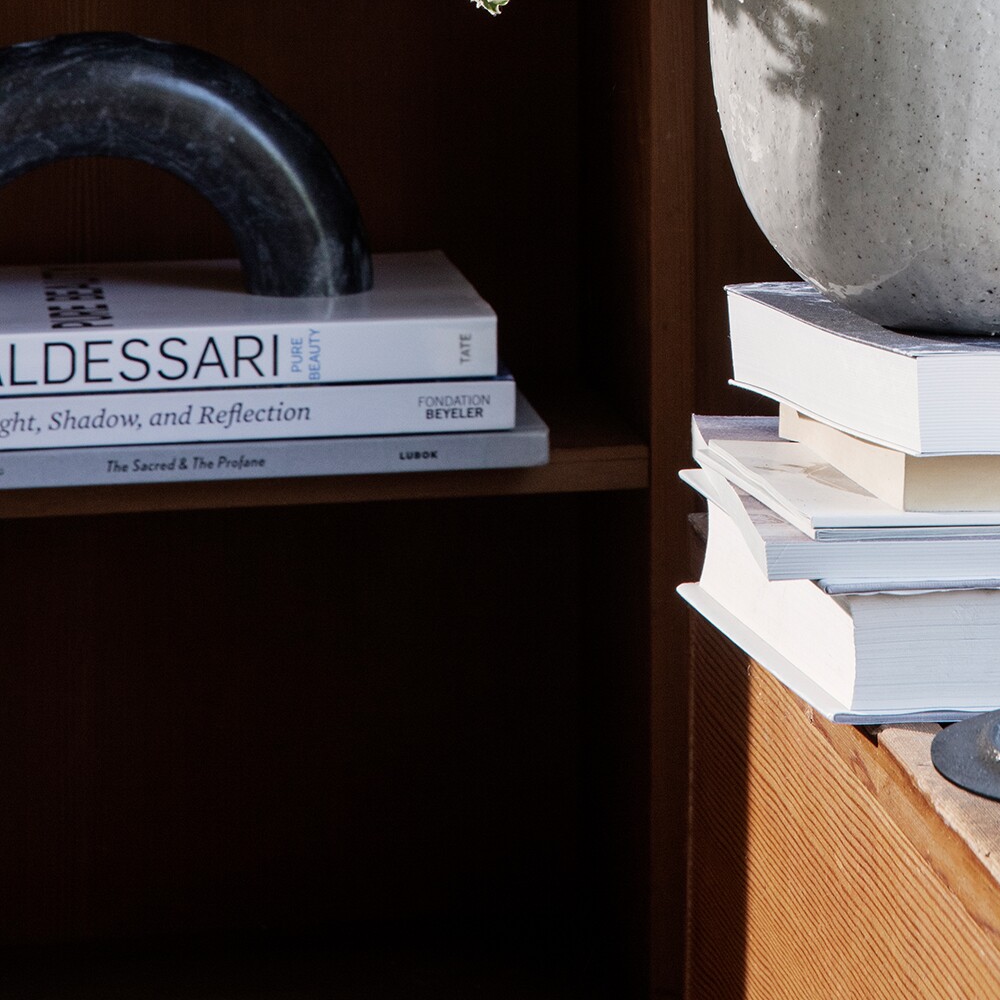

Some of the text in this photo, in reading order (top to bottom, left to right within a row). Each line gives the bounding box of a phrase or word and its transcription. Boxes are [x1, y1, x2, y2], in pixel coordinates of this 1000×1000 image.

[0, 334, 279, 387] LDESSARI
[291, 338, 303, 373] PURE
[309, 329, 321, 381] BEAUTY
[460, 333, 472, 365] TATE
[418, 395, 491, 407] FONDATION
[426, 407, 484, 420] BEYELER
[0, 402, 311, 438] ght, Shadow, and Reflection
[107, 455, 265, 473] The Sacred & The Profane
[399, 451, 438, 460] LUBOK
